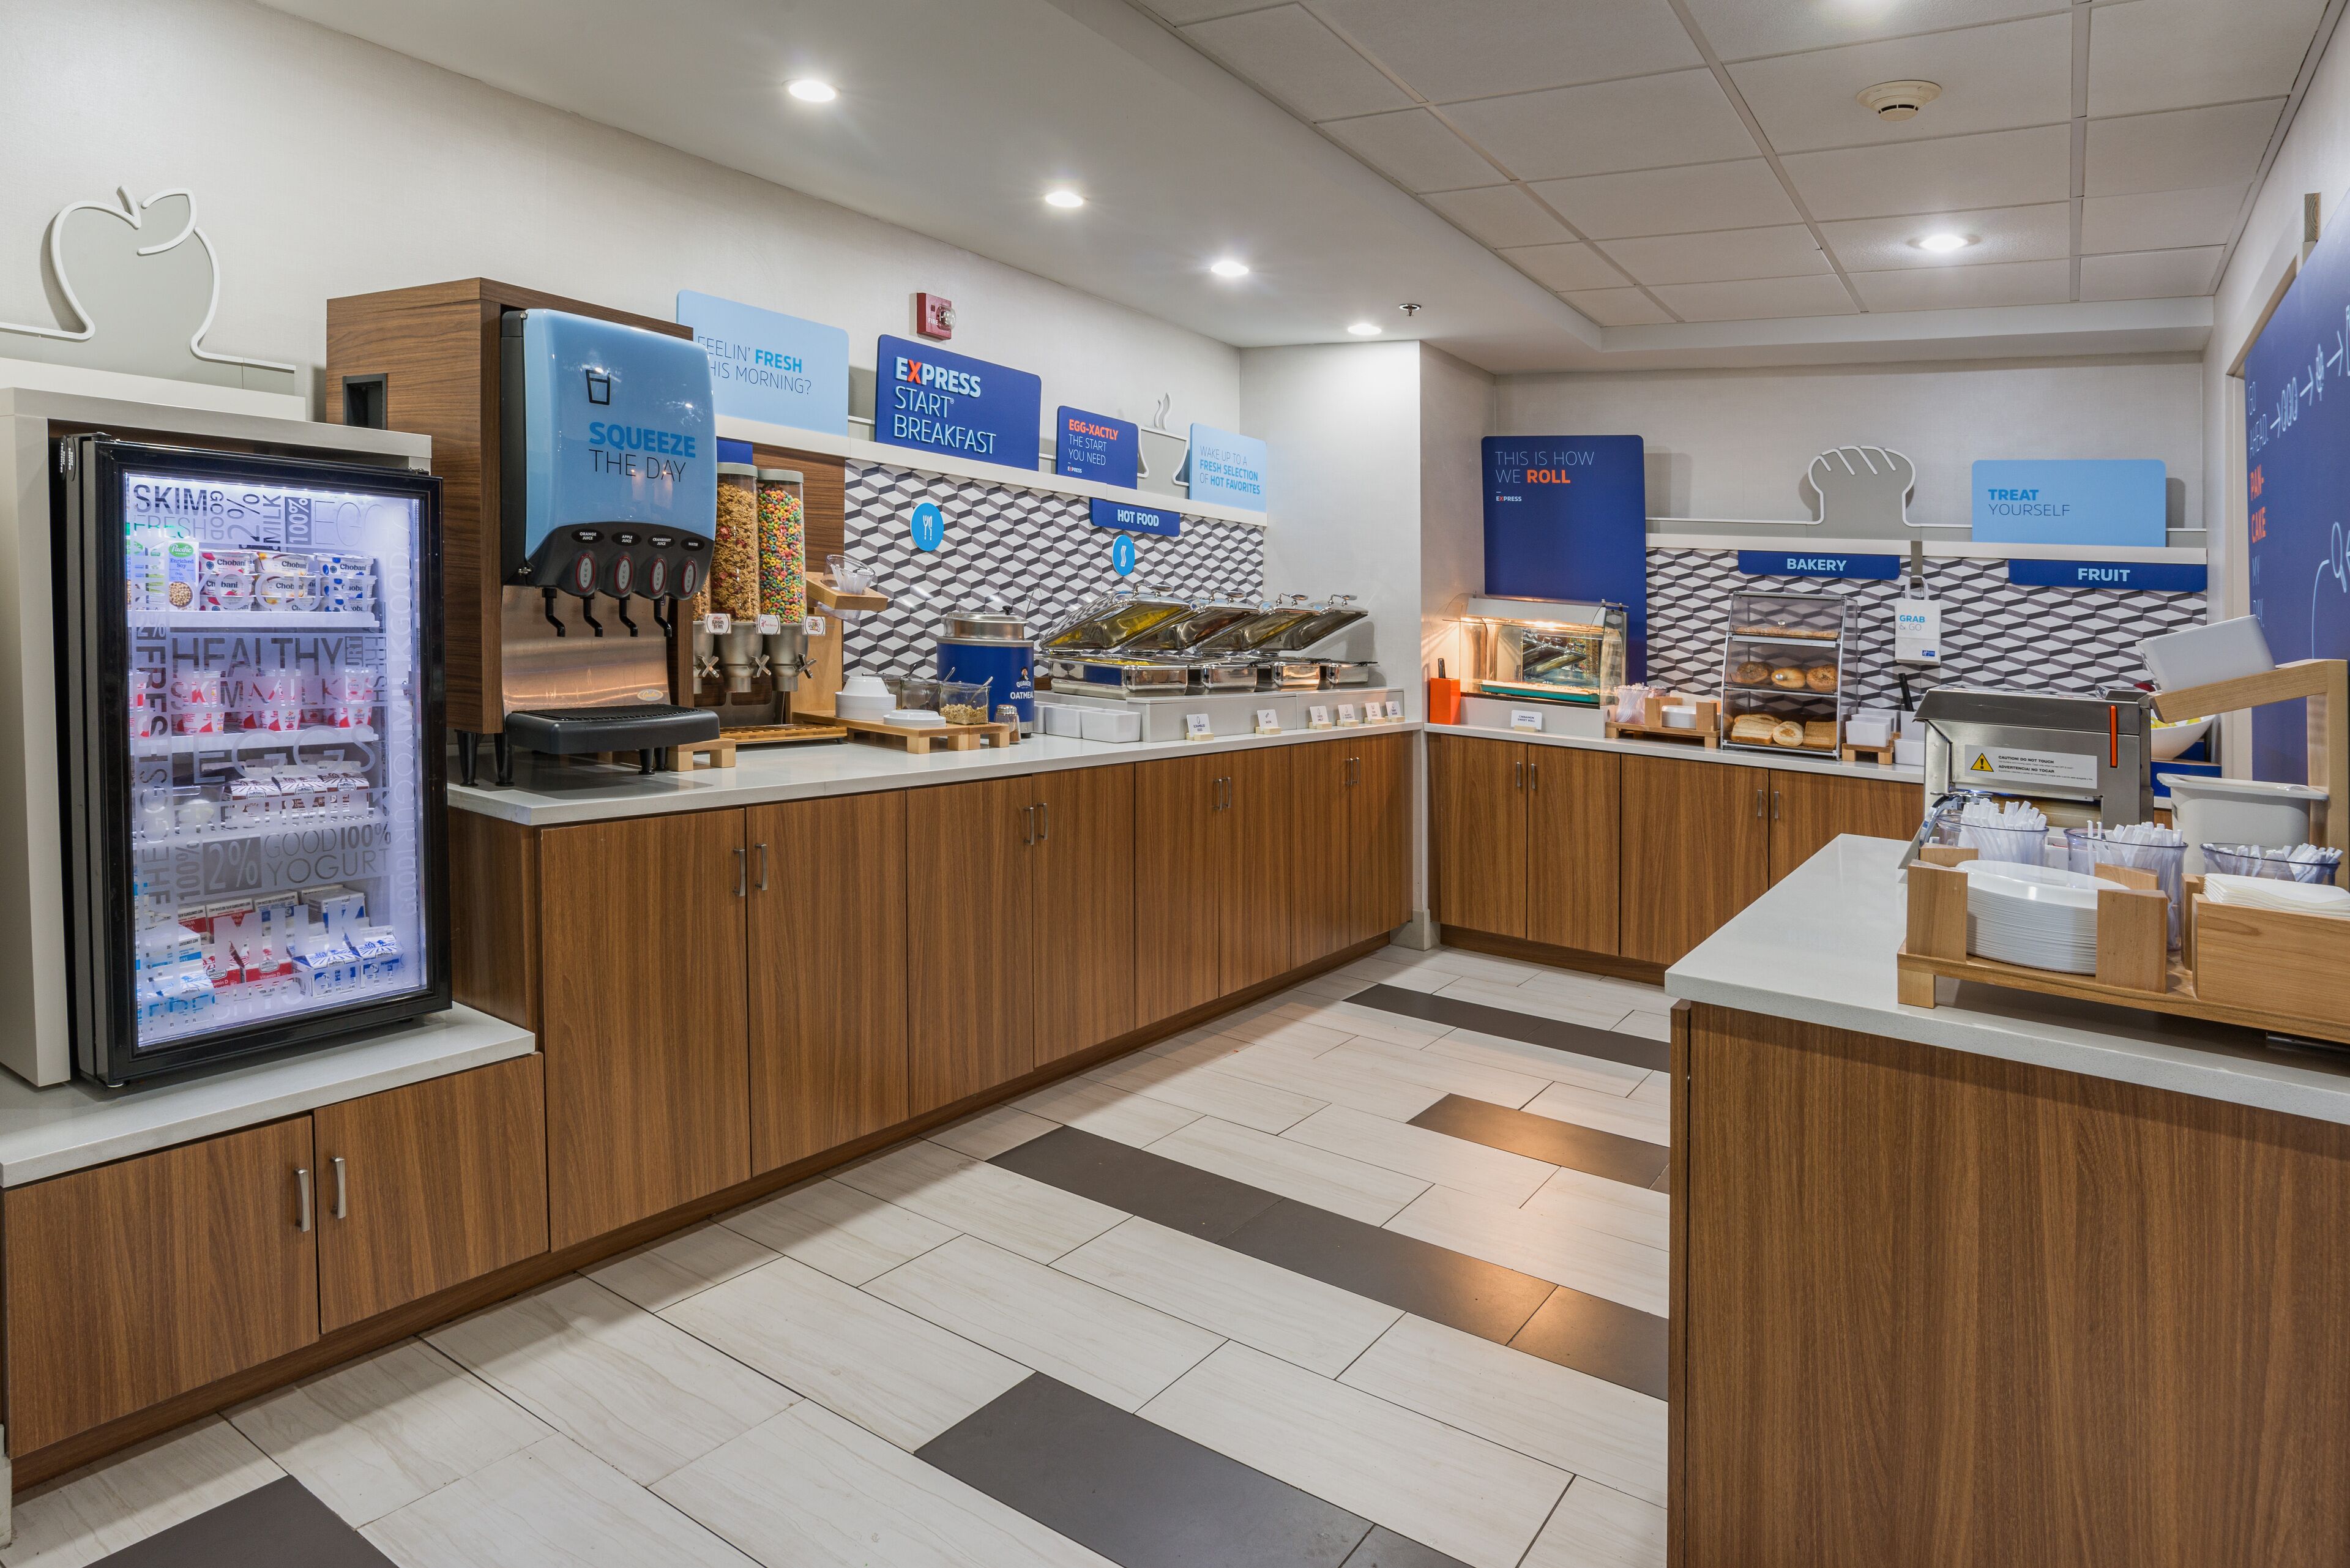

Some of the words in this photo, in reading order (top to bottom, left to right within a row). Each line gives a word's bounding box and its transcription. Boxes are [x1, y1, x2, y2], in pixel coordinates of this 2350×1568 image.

[755, 348, 802, 373] FRESH
[895, 356, 981, 398] EXPRESS
[710, 360, 730, 379] HIS
[736, 365, 811, 395] MORNING?
[2248, 381, 2256, 416] GO
[589, 422, 696, 458] SQUEEZE
[893, 414, 997, 455] BREAKFAST
[1069, 419, 1119, 441] EGG-XACTLY
[1069, 433, 1083, 448] THE
[1085, 438, 1106, 452] START
[589, 449, 636, 477] THE
[647, 457, 686, 482] DAY
[1068, 448, 1084, 461] YOU
[1087, 452, 1106, 466] NEED
[1199, 446, 1220, 460] WAKE
[1222, 451, 1231, 461] UP
[1233, 453, 1241, 465] TO
[1242, 456, 1247, 466] A
[1199, 459, 1222, 473] FRESH
[1223, 465, 1258, 482] SELECTION
[1495, 451, 1529, 466] THIS
[1534, 451, 1548, 466] IS
[1554, 451, 1595, 466] HOW
[1199, 472, 1209, 484] OF
[1210, 476, 1224, 487] HOT
[1226, 479, 1261, 495] FAVORITES
[1496, 469, 1521, 483] WE
[1527, 469, 1571, 483] ROLL
[2250, 464, 2264, 501] PAN-
[133, 484, 207, 517] SKIM
[1988, 489, 2039, 501] TREAT
[1988, 504, 2070, 517] YOURSELF
[134, 514, 207, 540] FRESH
[210, 490, 225, 541] GOOD
[226, 493, 261, 542] 2%
[263, 495, 282, 543] MILK
[288, 498, 310, 543] 100%
[1117, 509, 1135, 523] HOT
[1136, 512, 1160, 527] FOOD
[2251, 506, 2266, 544] CAKE
[171, 543, 192, 553] Pacific
[282, 561, 306, 569] Chobani
[1787, 558, 1847, 572] BAKERY
[2078, 568, 2130, 582] FRUIT
[2252, 554, 2260, 586] MY
[1900, 614, 1925, 623] GRAB
[171, 637, 343, 678] HEALTHY
[136, 646, 168, 763] FRESH
[171, 680, 244, 711] SKIM
[193, 723, 376, 784] EGGS
[264, 828, 337, 858] GOOD
[340, 821, 392, 851] 100%
[175, 840, 201, 902] 100%
[209, 838, 258, 890] 2%
[267, 848, 390, 886] YOGURT
[214, 896, 366, 971] MILK
